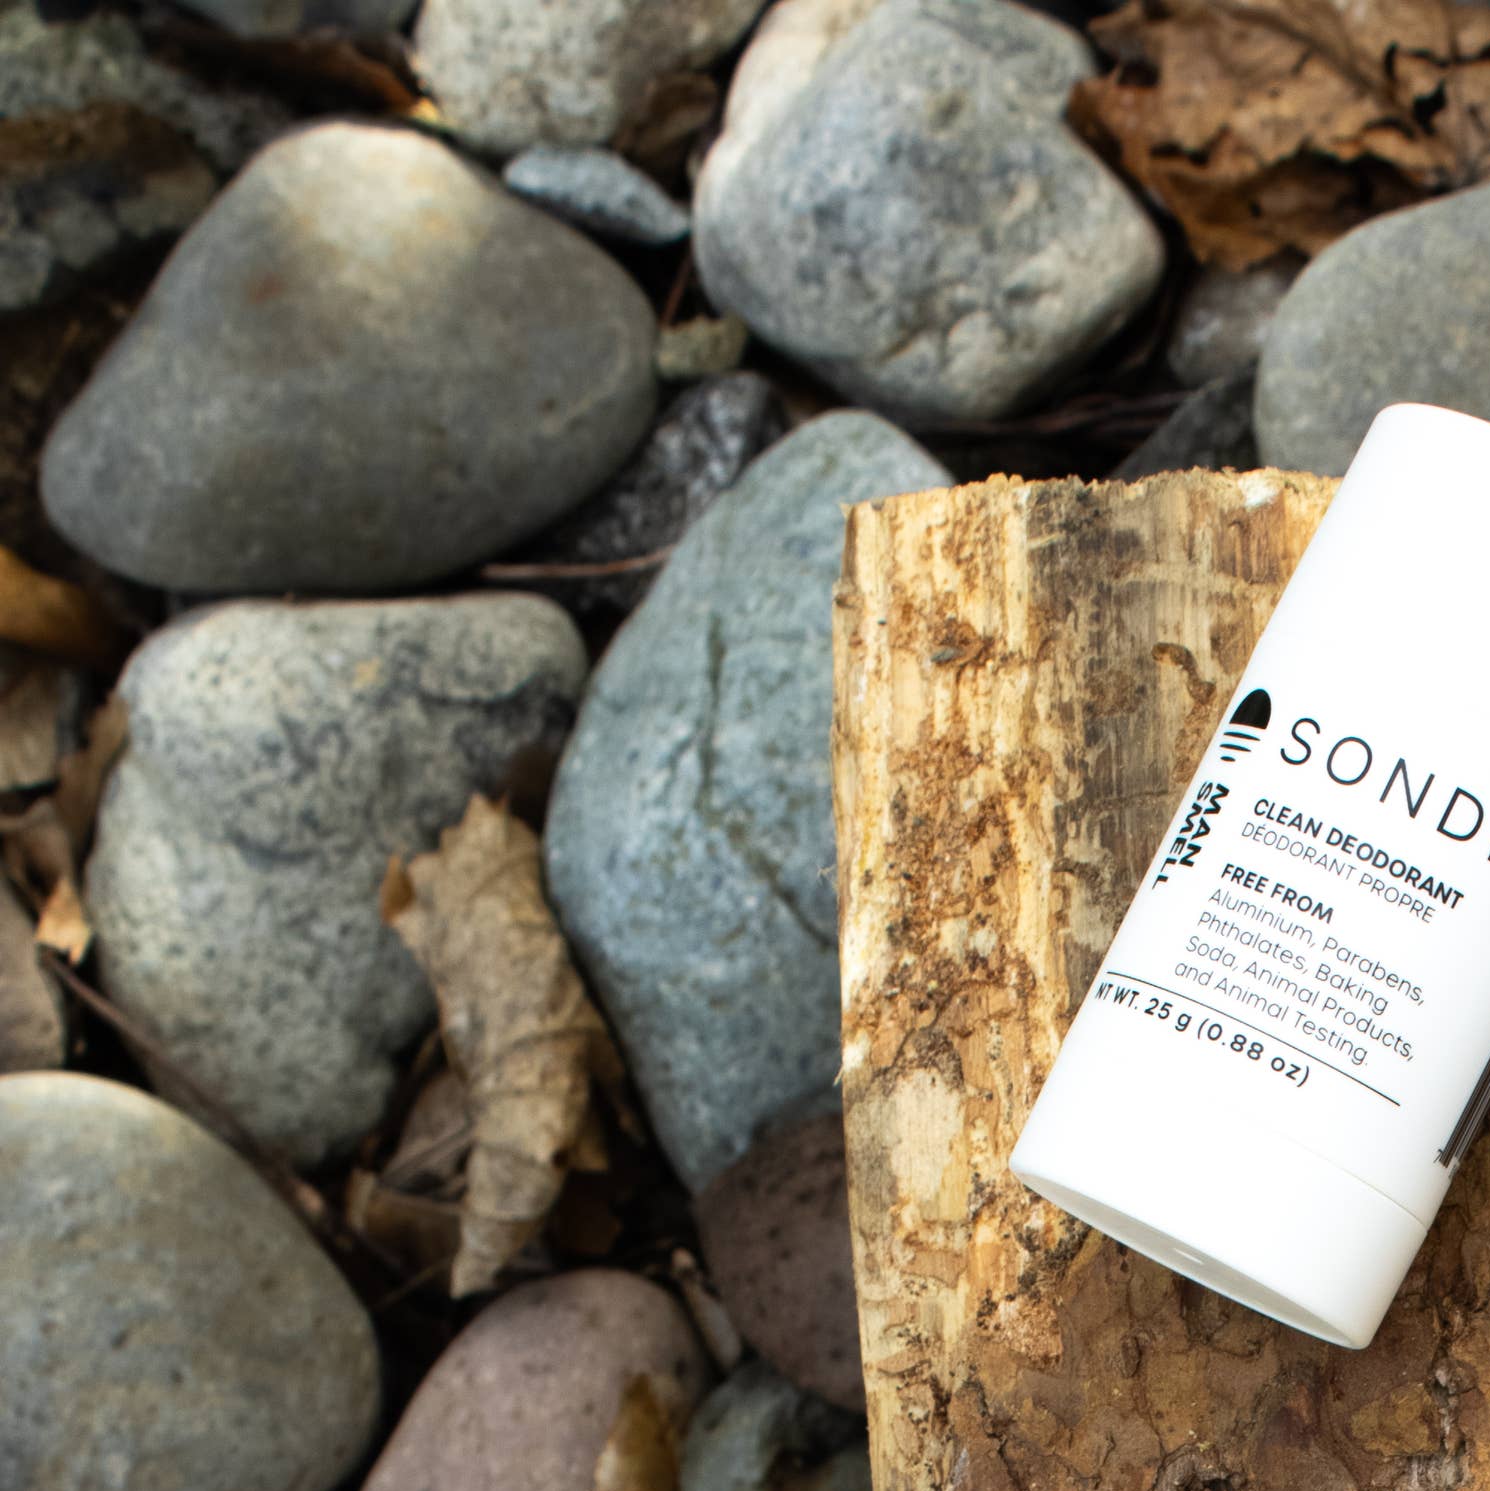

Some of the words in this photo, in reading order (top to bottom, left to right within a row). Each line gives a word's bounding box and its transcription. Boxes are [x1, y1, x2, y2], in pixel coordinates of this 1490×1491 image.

[1152, 781, 1211, 891] SMELL
[1178, 784, 1230, 868] MAN
[1241, 822, 1357, 881] DÉODORANT
[1359, 873, 1435, 923] PROPRE
[1253, 798, 1320, 847] CLEAN
[1326, 828, 1464, 910] DEODORANT
[1208, 888, 1315, 947] Aluminium,
[1322, 937, 1425, 1005] Parabens,
[1221, 863, 1269, 893] FREE
[1270, 883, 1334, 925] FROM
[1174, 963, 1214, 986] and
[1214, 977, 1289, 1021] Animal
[1295, 1011, 1368, 1066] Testing.
[1186, 935, 1238, 971] Soda,
[1244, 961, 1319, 1007] Animal
[1322, 997, 1415, 1061] Products,
[1197, 912, 1308, 974] Phthalates,
[1314, 964, 1389, 1016] Baking
[1094, 982, 1113, 1000] NT
[1112, 987, 1140, 1010] WT.
[1144, 997, 1173, 1020] 25
[1175, 1013, 1192, 1032] g
[1197, 1018, 1265, 1061] (0.88
[1270, 1056, 1310, 1088] oz)
